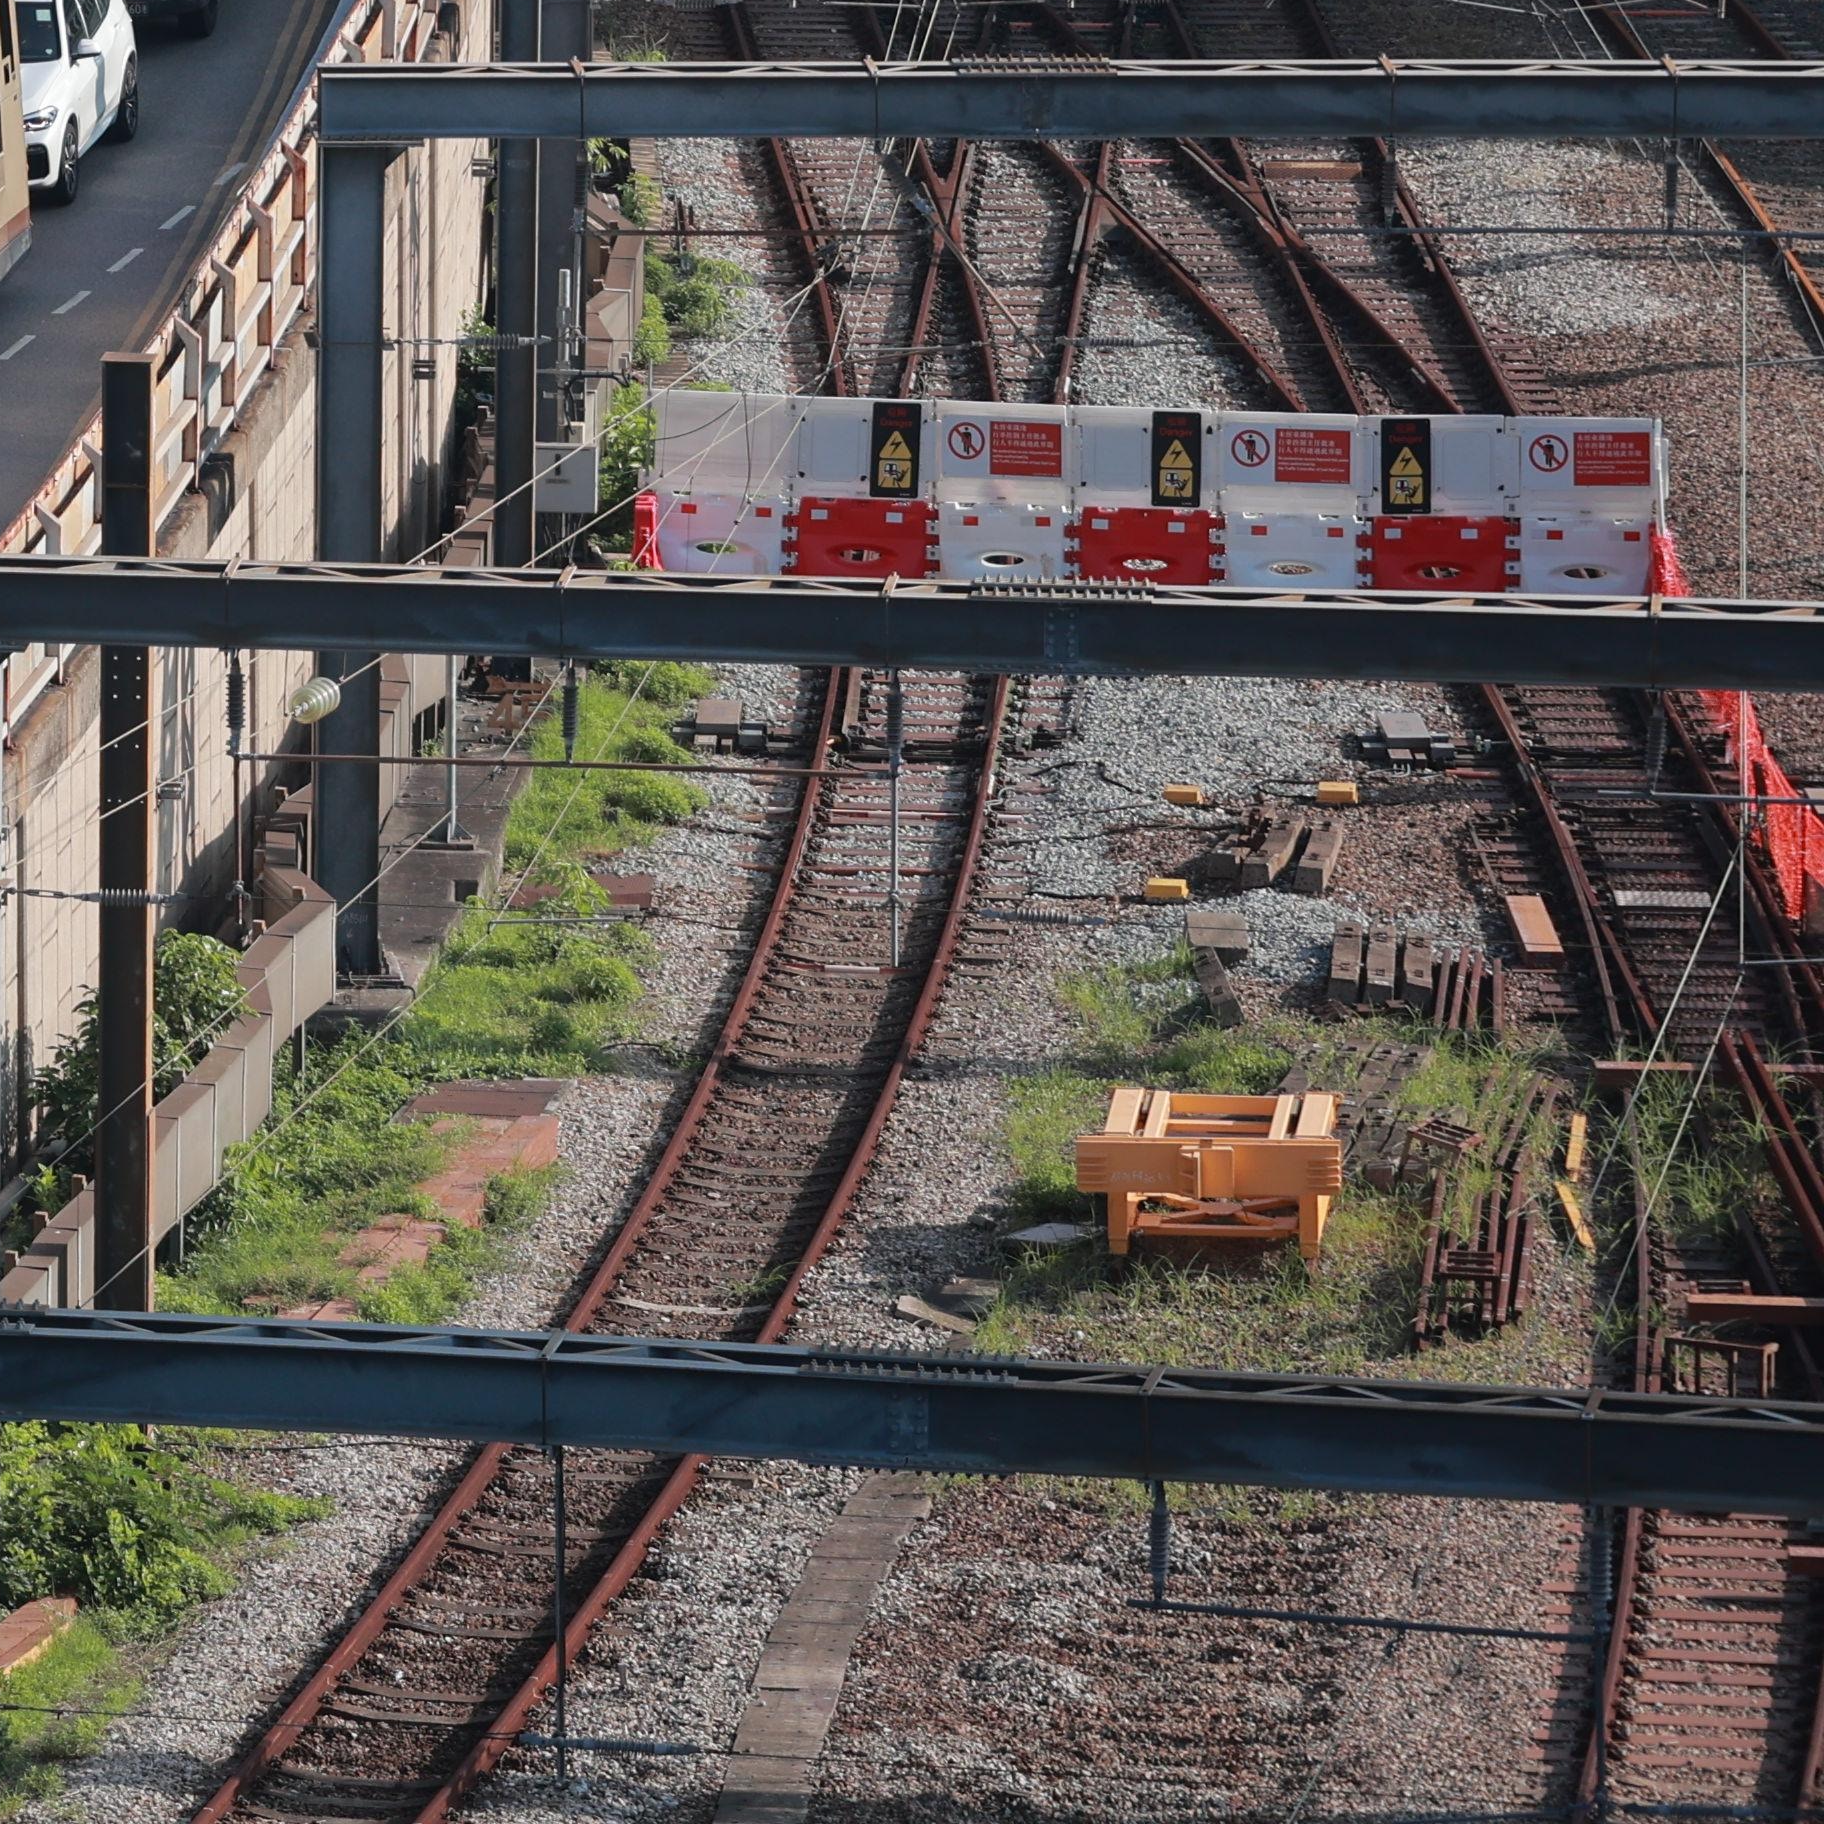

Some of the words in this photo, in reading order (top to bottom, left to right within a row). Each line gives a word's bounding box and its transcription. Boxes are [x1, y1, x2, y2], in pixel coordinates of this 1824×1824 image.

[880, 418, 913, 428] Danger
[1159, 427, 1193, 438] Danger
[1389, 435, 1424, 444] Danger
